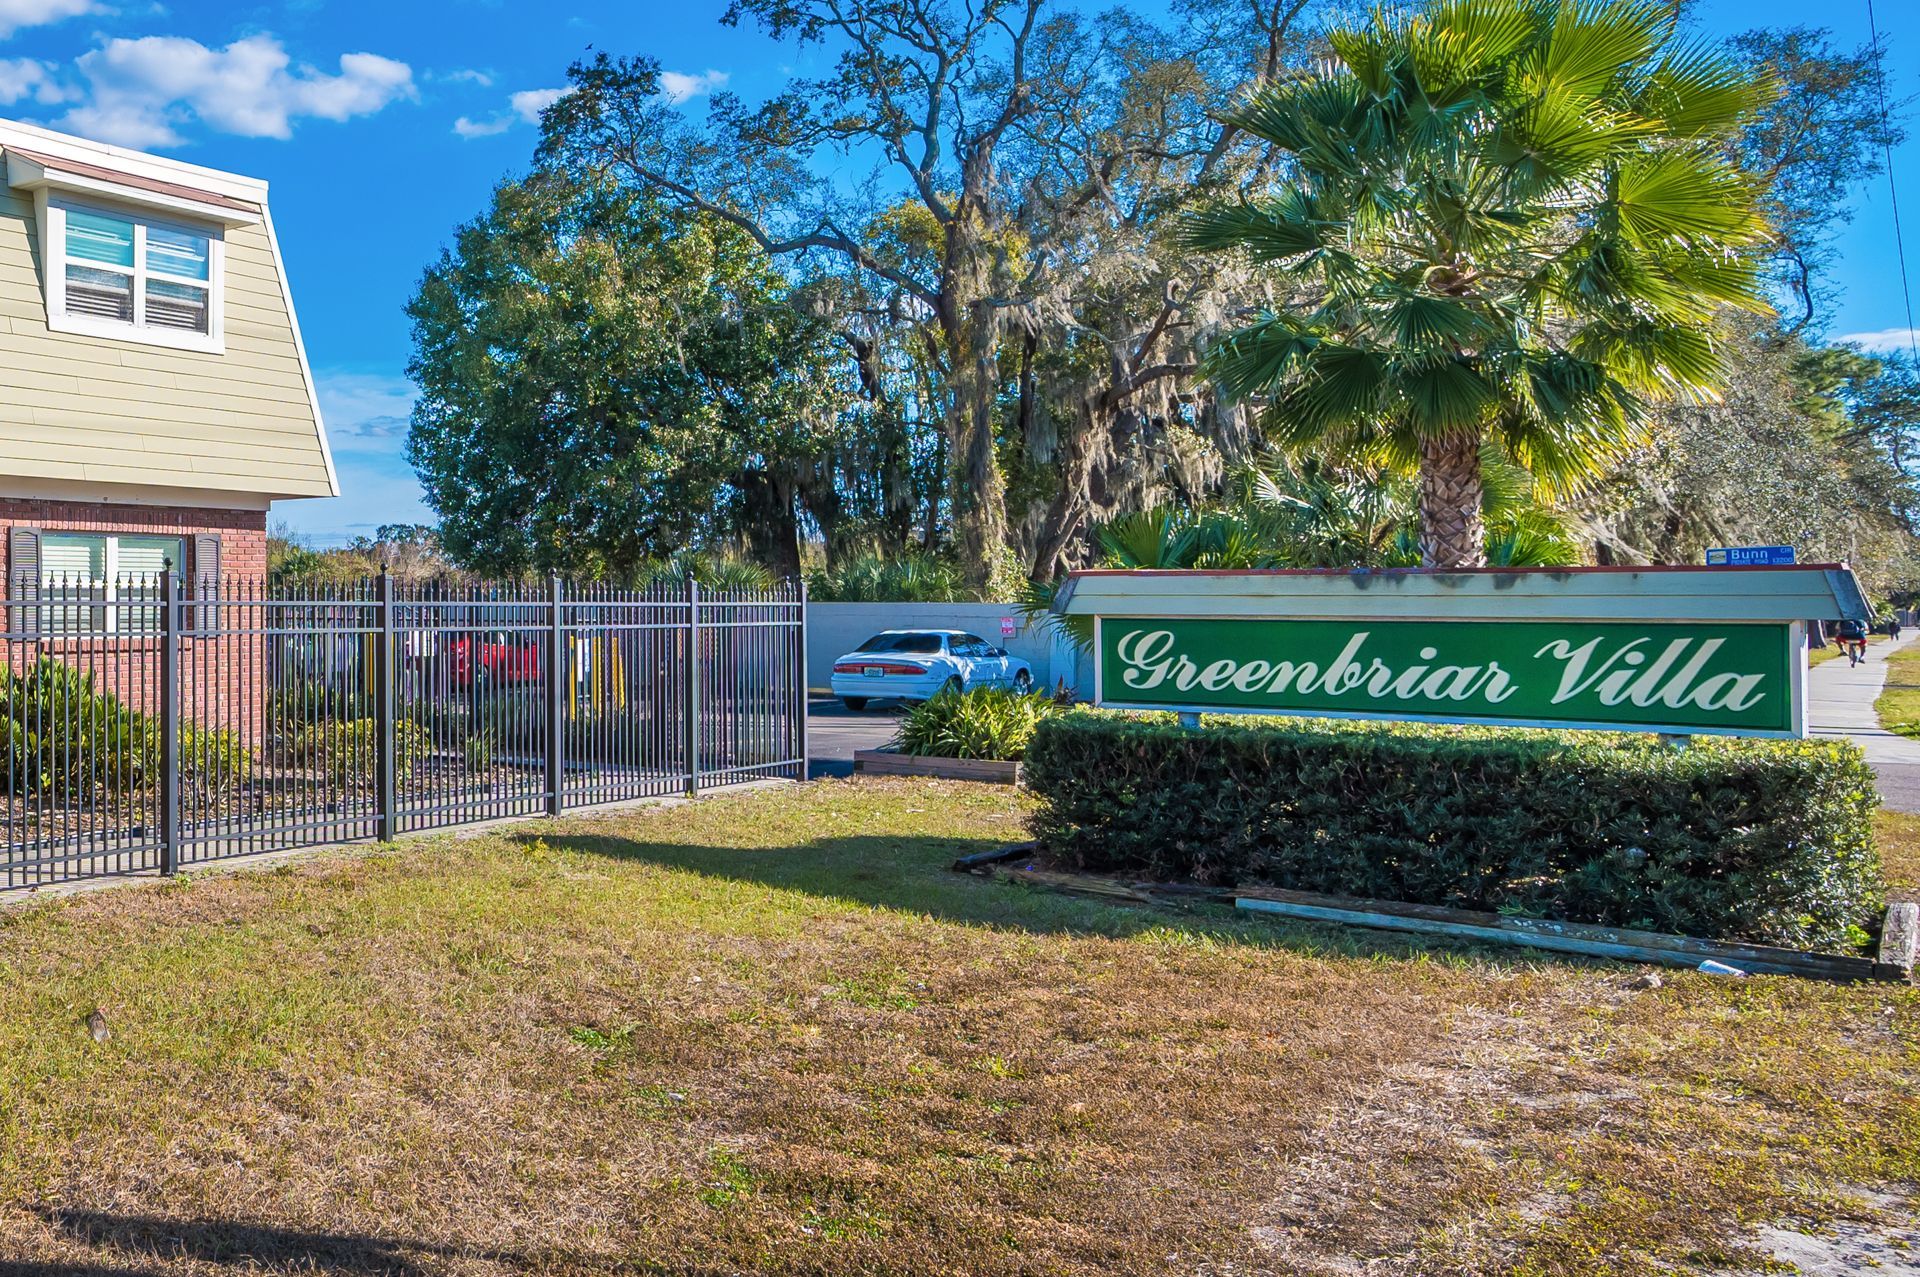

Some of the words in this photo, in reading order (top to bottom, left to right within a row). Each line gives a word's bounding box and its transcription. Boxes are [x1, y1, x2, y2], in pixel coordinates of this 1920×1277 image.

[1731, 550, 1768, 560] Bunn
[1117, 629, 1519, 703] Greenbriar
[1534, 635, 1764, 712] Villa
